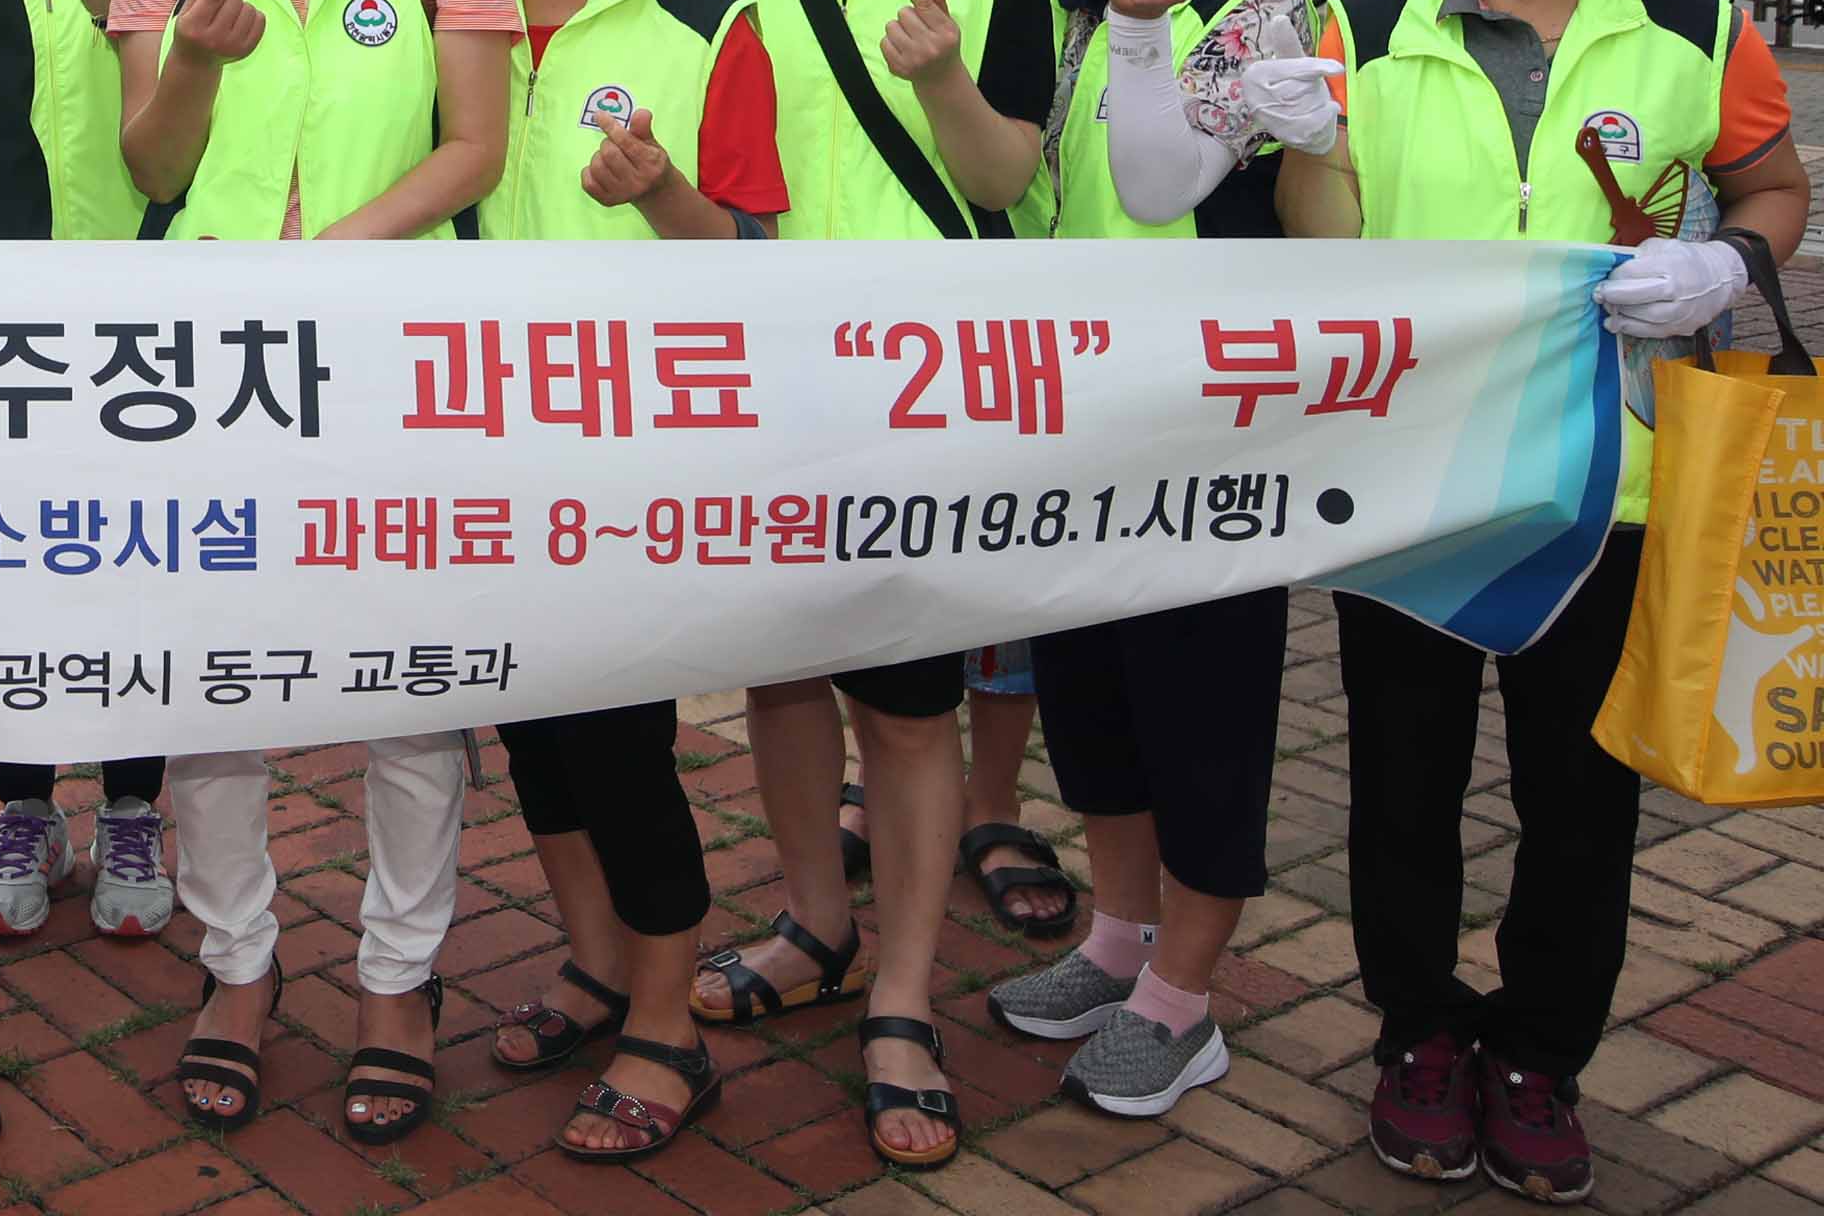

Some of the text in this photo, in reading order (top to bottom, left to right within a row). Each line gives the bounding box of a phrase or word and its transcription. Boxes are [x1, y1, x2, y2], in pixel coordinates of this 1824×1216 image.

[402, 319, 759, 438] 과태료
[1200, 317, 1419, 428] 부과
[1771, 491, 1824, 519] LO
[295, 497, 515, 571] 과태료
[1759, 526, 1824, 552] CLE
[1769, 592, 1824, 618] PLE
[199, 649, 318, 705] 동구
[341, 642, 519, 697] 교통과
[1784, 654, 1824, 680] W
[1765, 740, 1824, 771] OU
